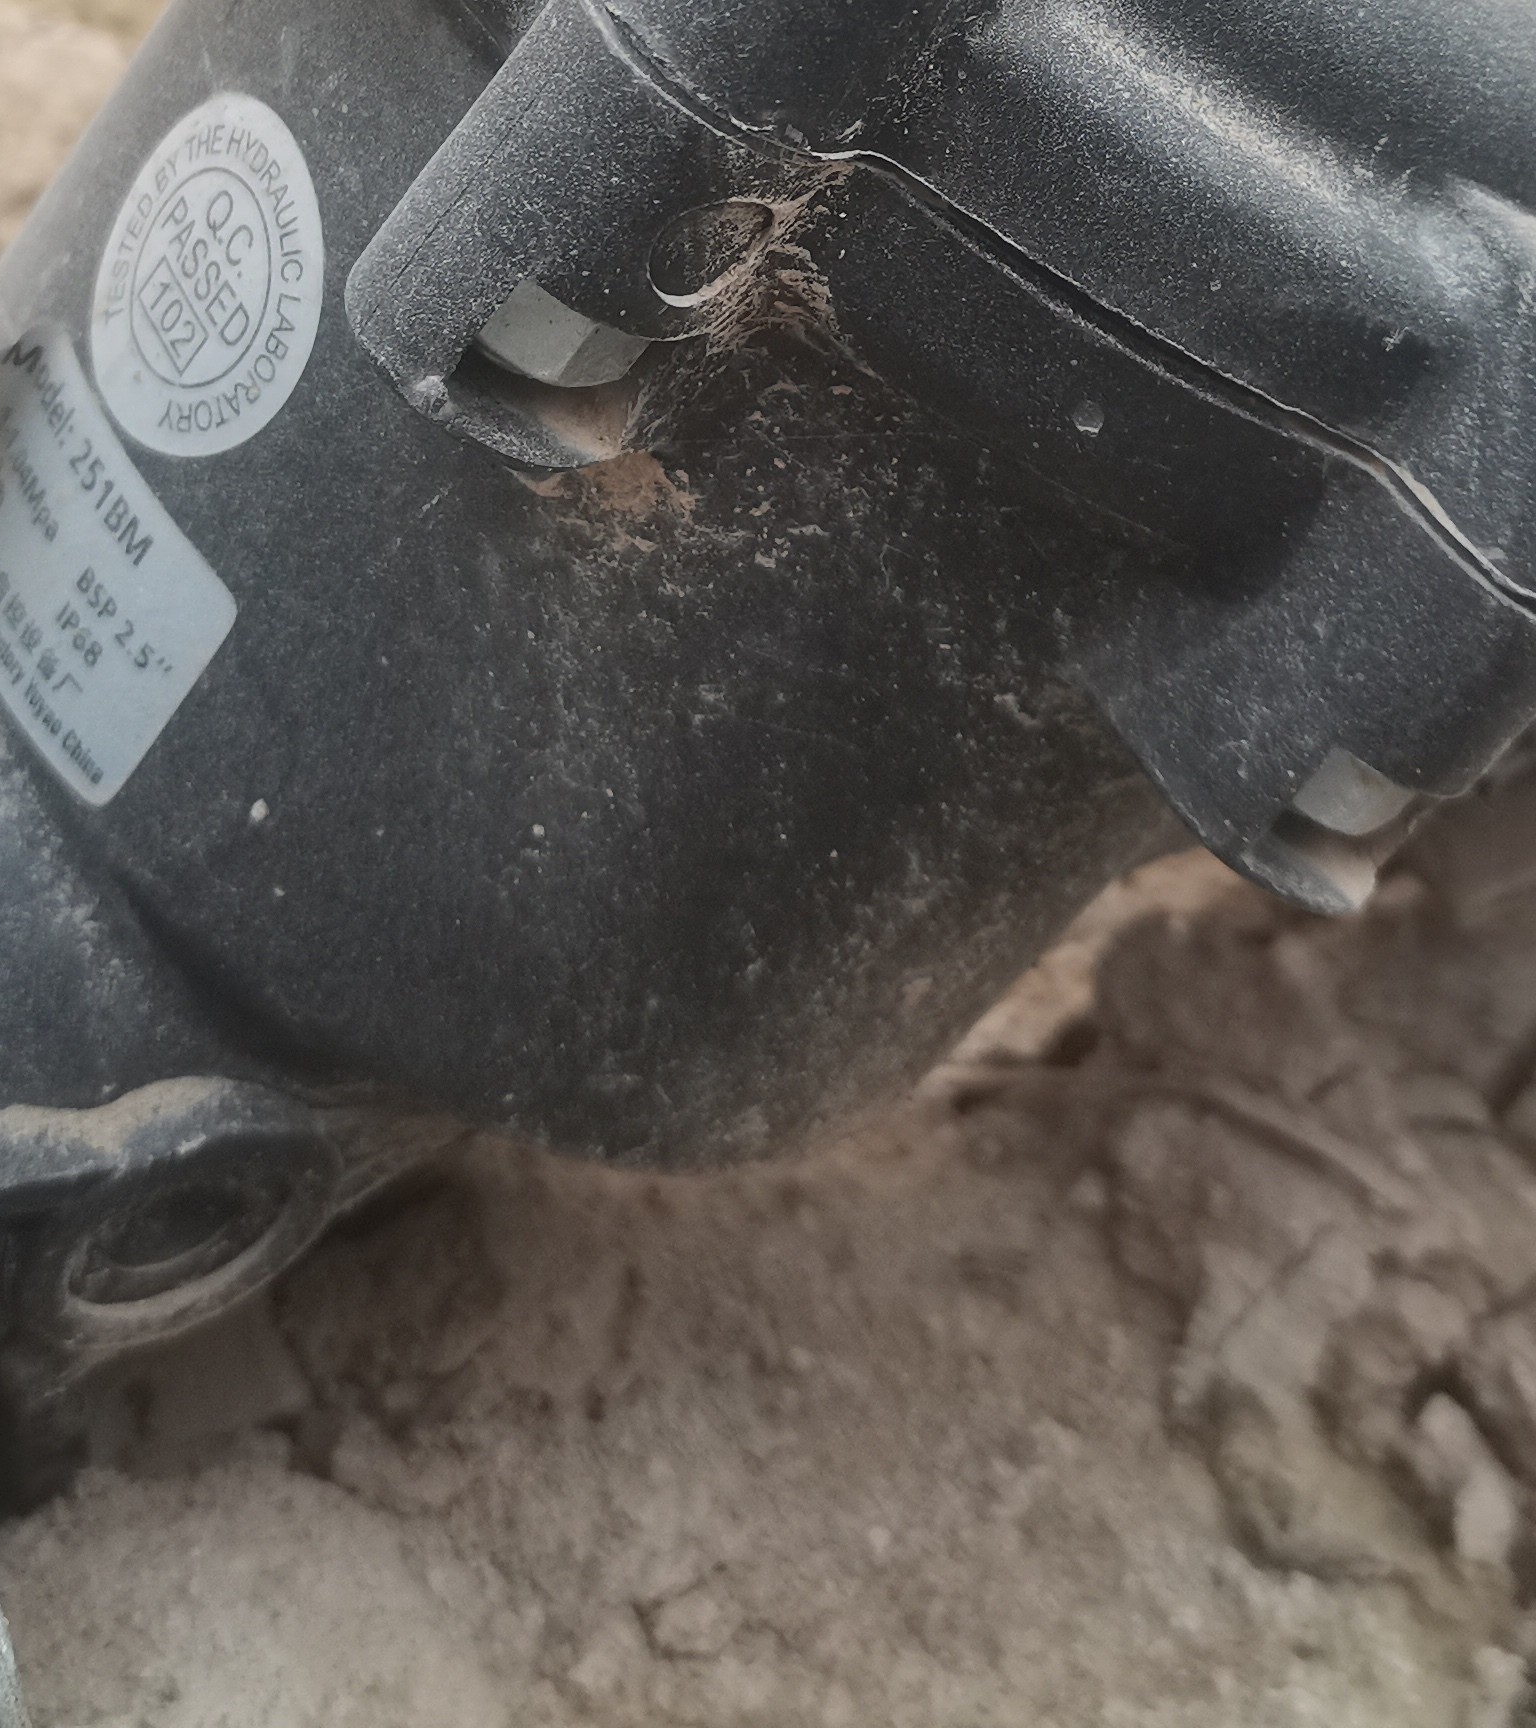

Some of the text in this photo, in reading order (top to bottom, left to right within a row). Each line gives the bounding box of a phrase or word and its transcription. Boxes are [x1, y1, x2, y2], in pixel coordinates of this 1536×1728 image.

[161, 195, 250, 347] PASSED
[206, 189, 254, 279] Q.C.
[104, 124, 304, 433] TESTED BY THE HYDRAULIC LABORATORY
[149, 281, 196, 359] 102
[68, 436, 155, 567] 251BM
[75, 565, 118, 619] BSP
[55, 600, 104, 669] IP68
[62, 728, 105, 785] China
